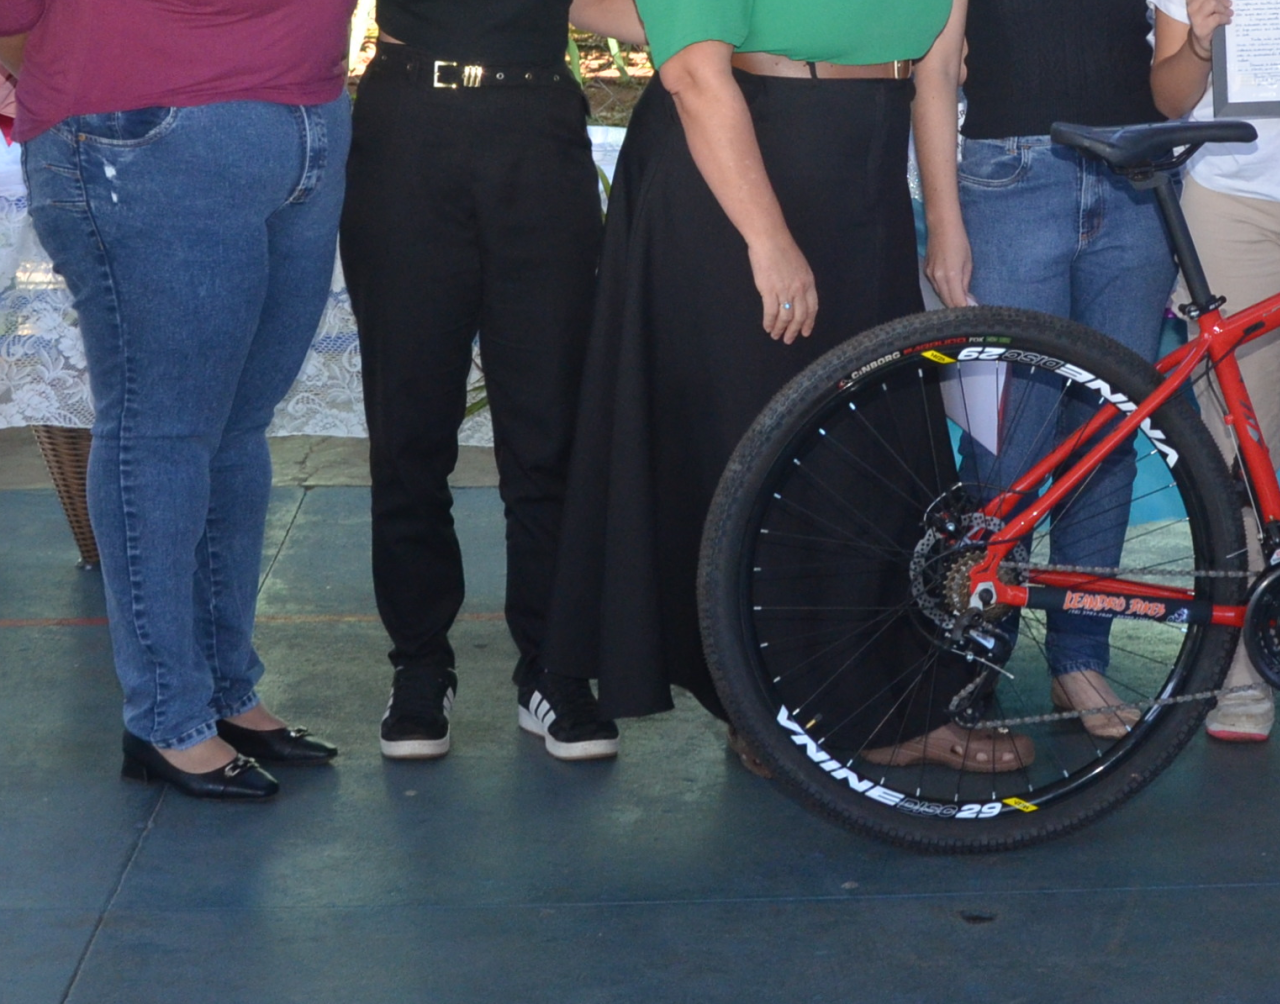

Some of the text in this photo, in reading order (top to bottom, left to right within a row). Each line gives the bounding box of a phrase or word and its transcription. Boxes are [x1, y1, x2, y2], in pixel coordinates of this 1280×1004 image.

[957, 346, 1007, 361] 29
[1062, 590, 1126, 612] LEANDRO
[1125, 597, 1166, 619] BIKES
[897, 797, 958, 818] DISC
[955, 801, 1003, 819] 29
